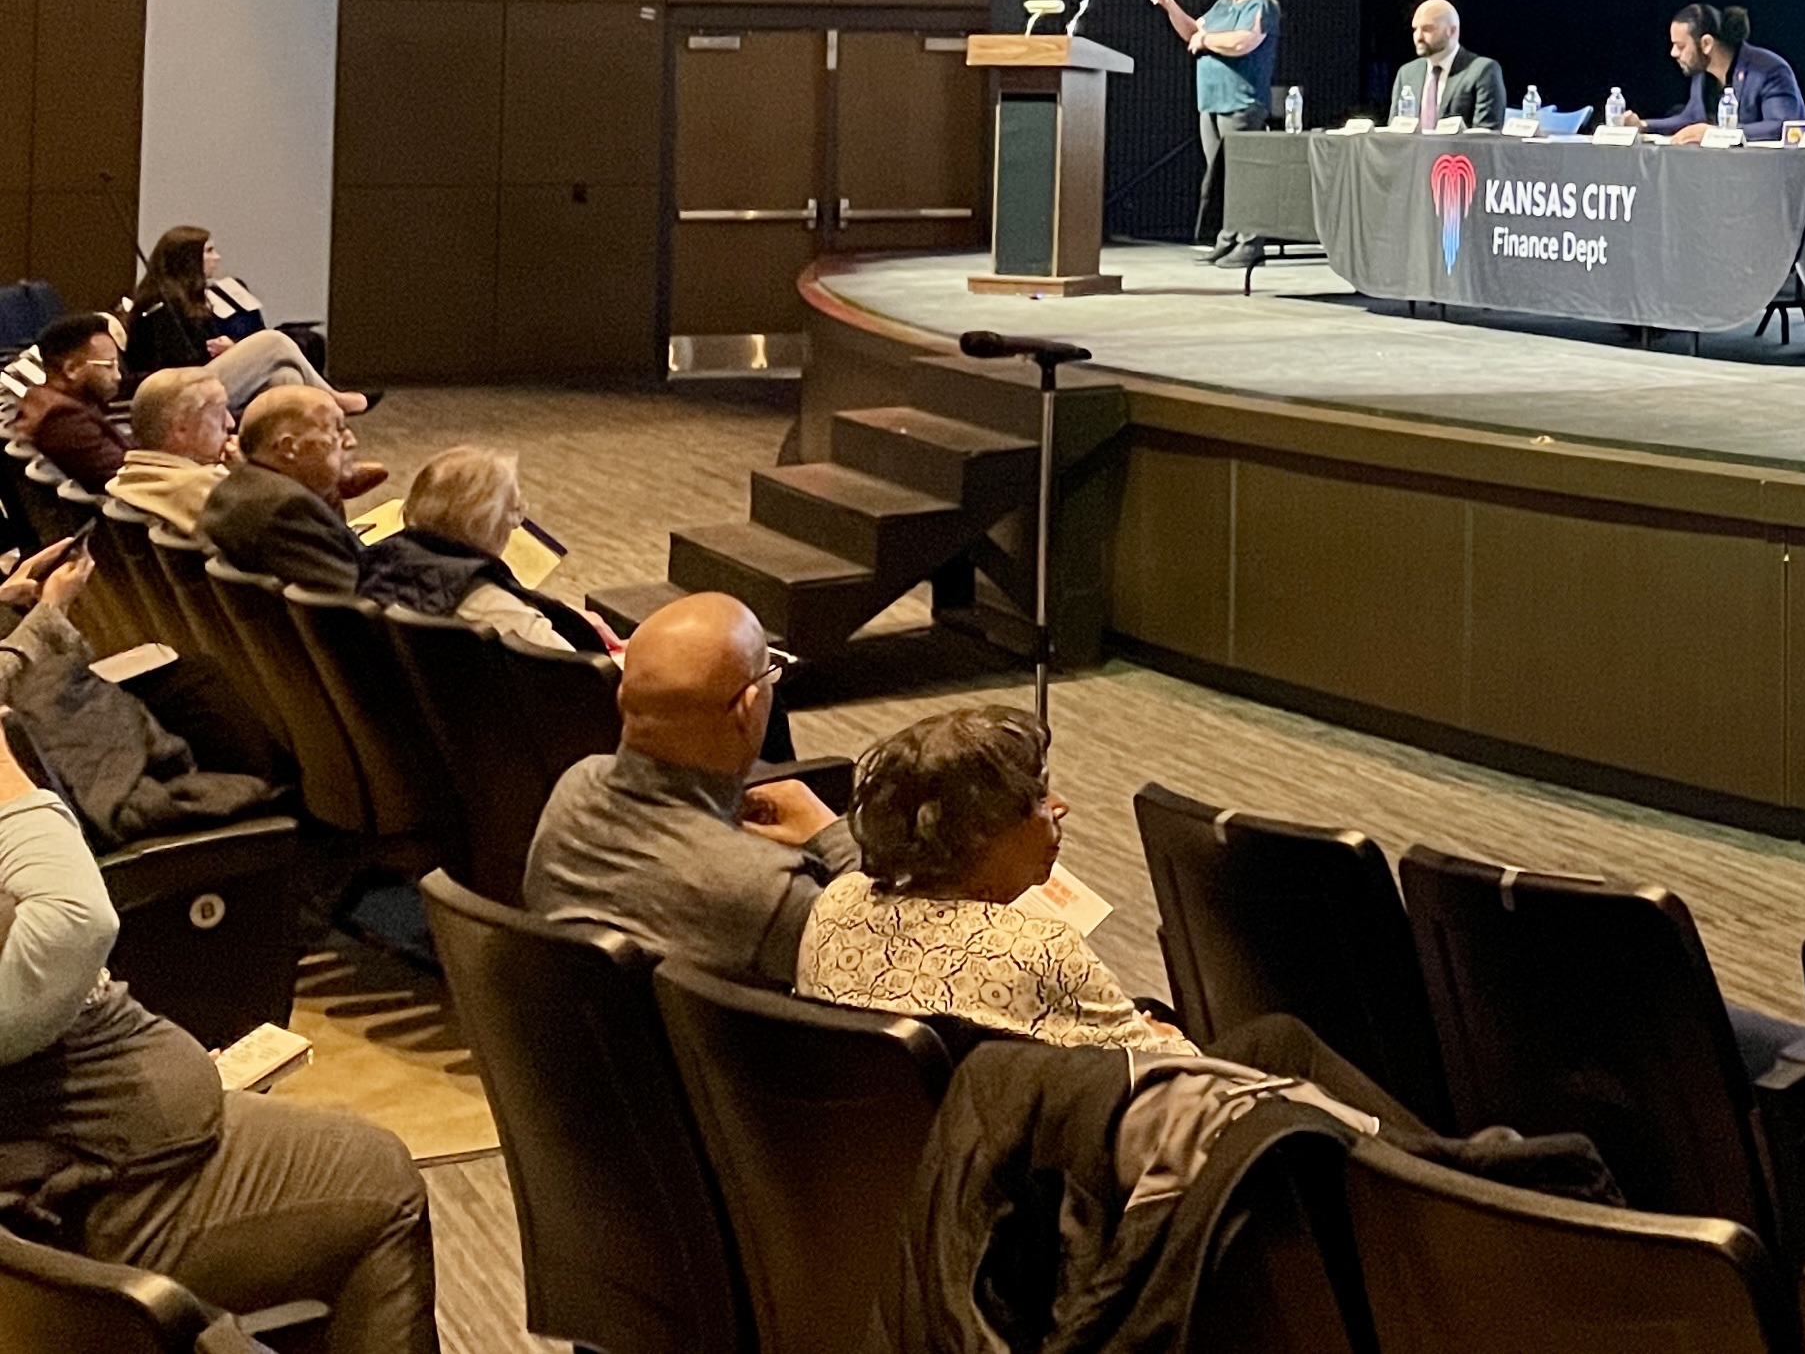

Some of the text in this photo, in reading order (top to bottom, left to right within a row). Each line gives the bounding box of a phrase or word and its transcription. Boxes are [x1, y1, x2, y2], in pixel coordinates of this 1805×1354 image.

[1484, 179, 1637, 222] KANSAS CITY
[1492, 226, 1608, 272] Finance Dept
